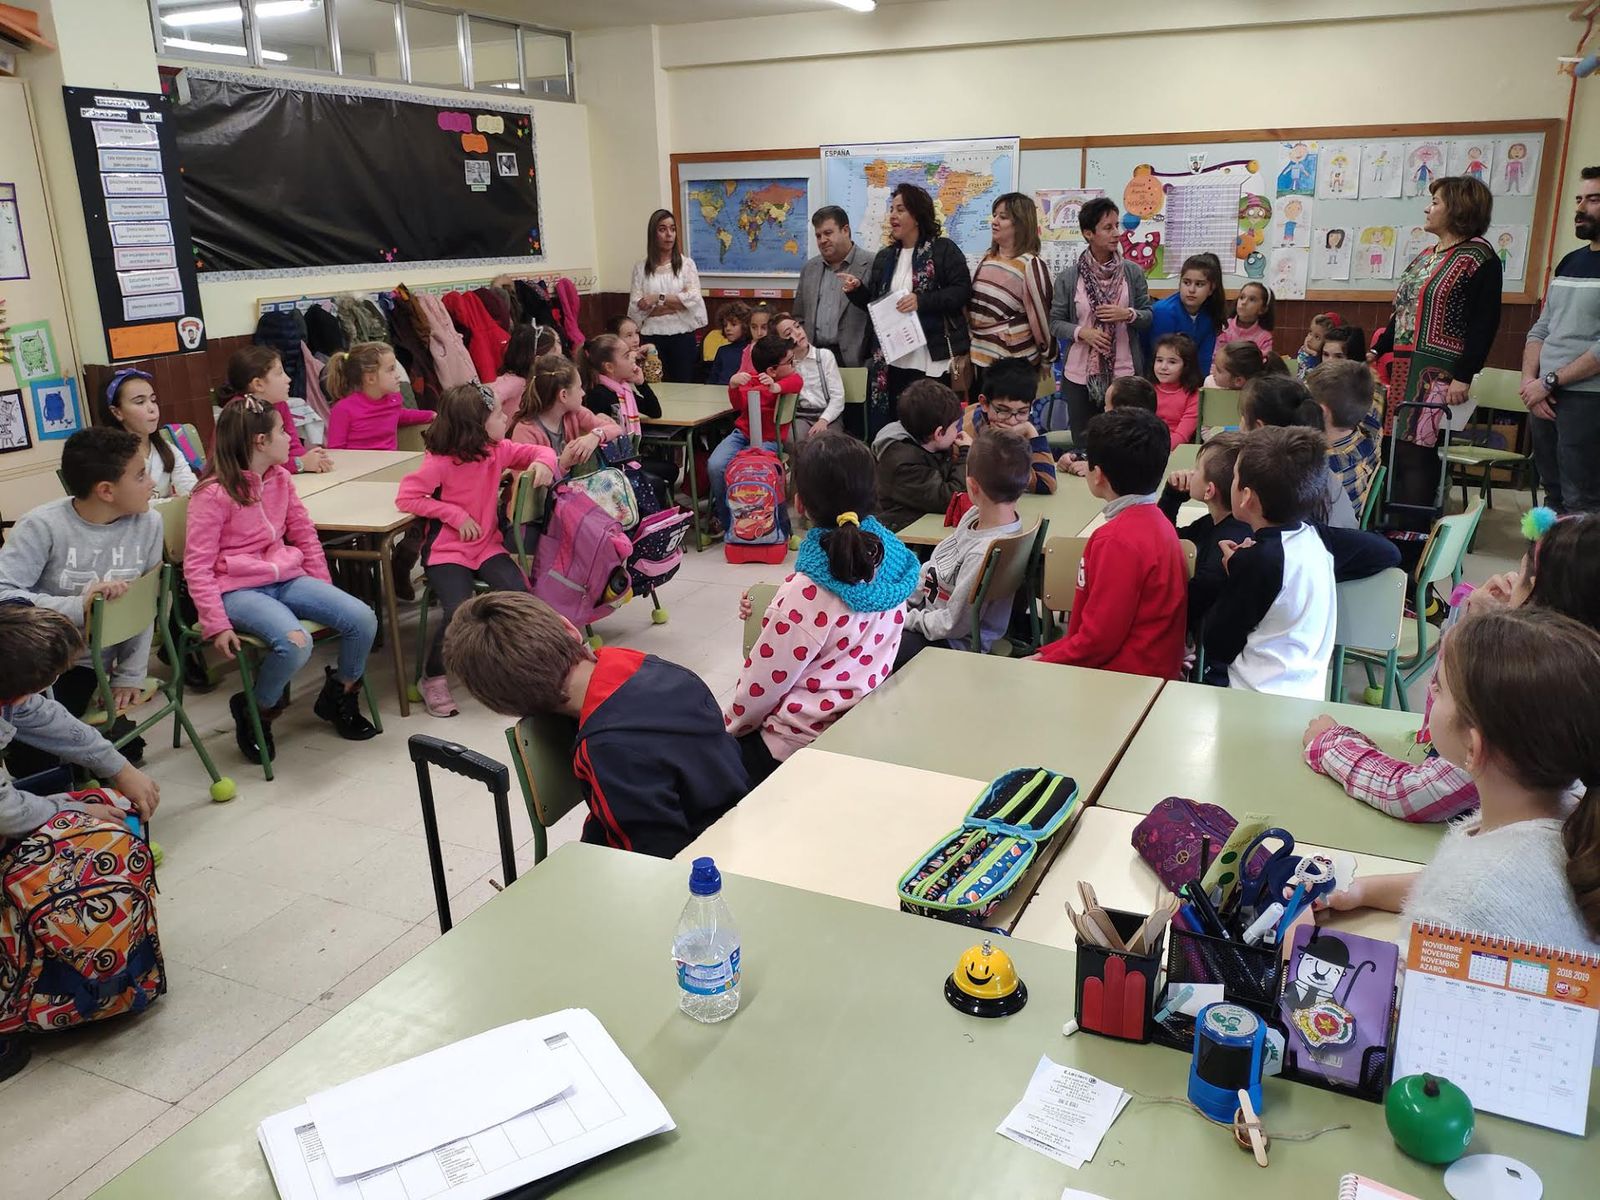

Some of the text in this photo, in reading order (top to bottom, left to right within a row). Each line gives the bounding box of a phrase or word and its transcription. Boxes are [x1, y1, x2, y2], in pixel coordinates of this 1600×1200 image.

[824, 149, 851, 157] ESPAÑA
[1422, 940, 1463, 954] NOVIEMBRE
[1421, 948, 1460, 962] NOVEMBRE
[1420, 956, 1460, 969] NOVEMBRO
[1556, 967, 1590, 982] 2018 2019
